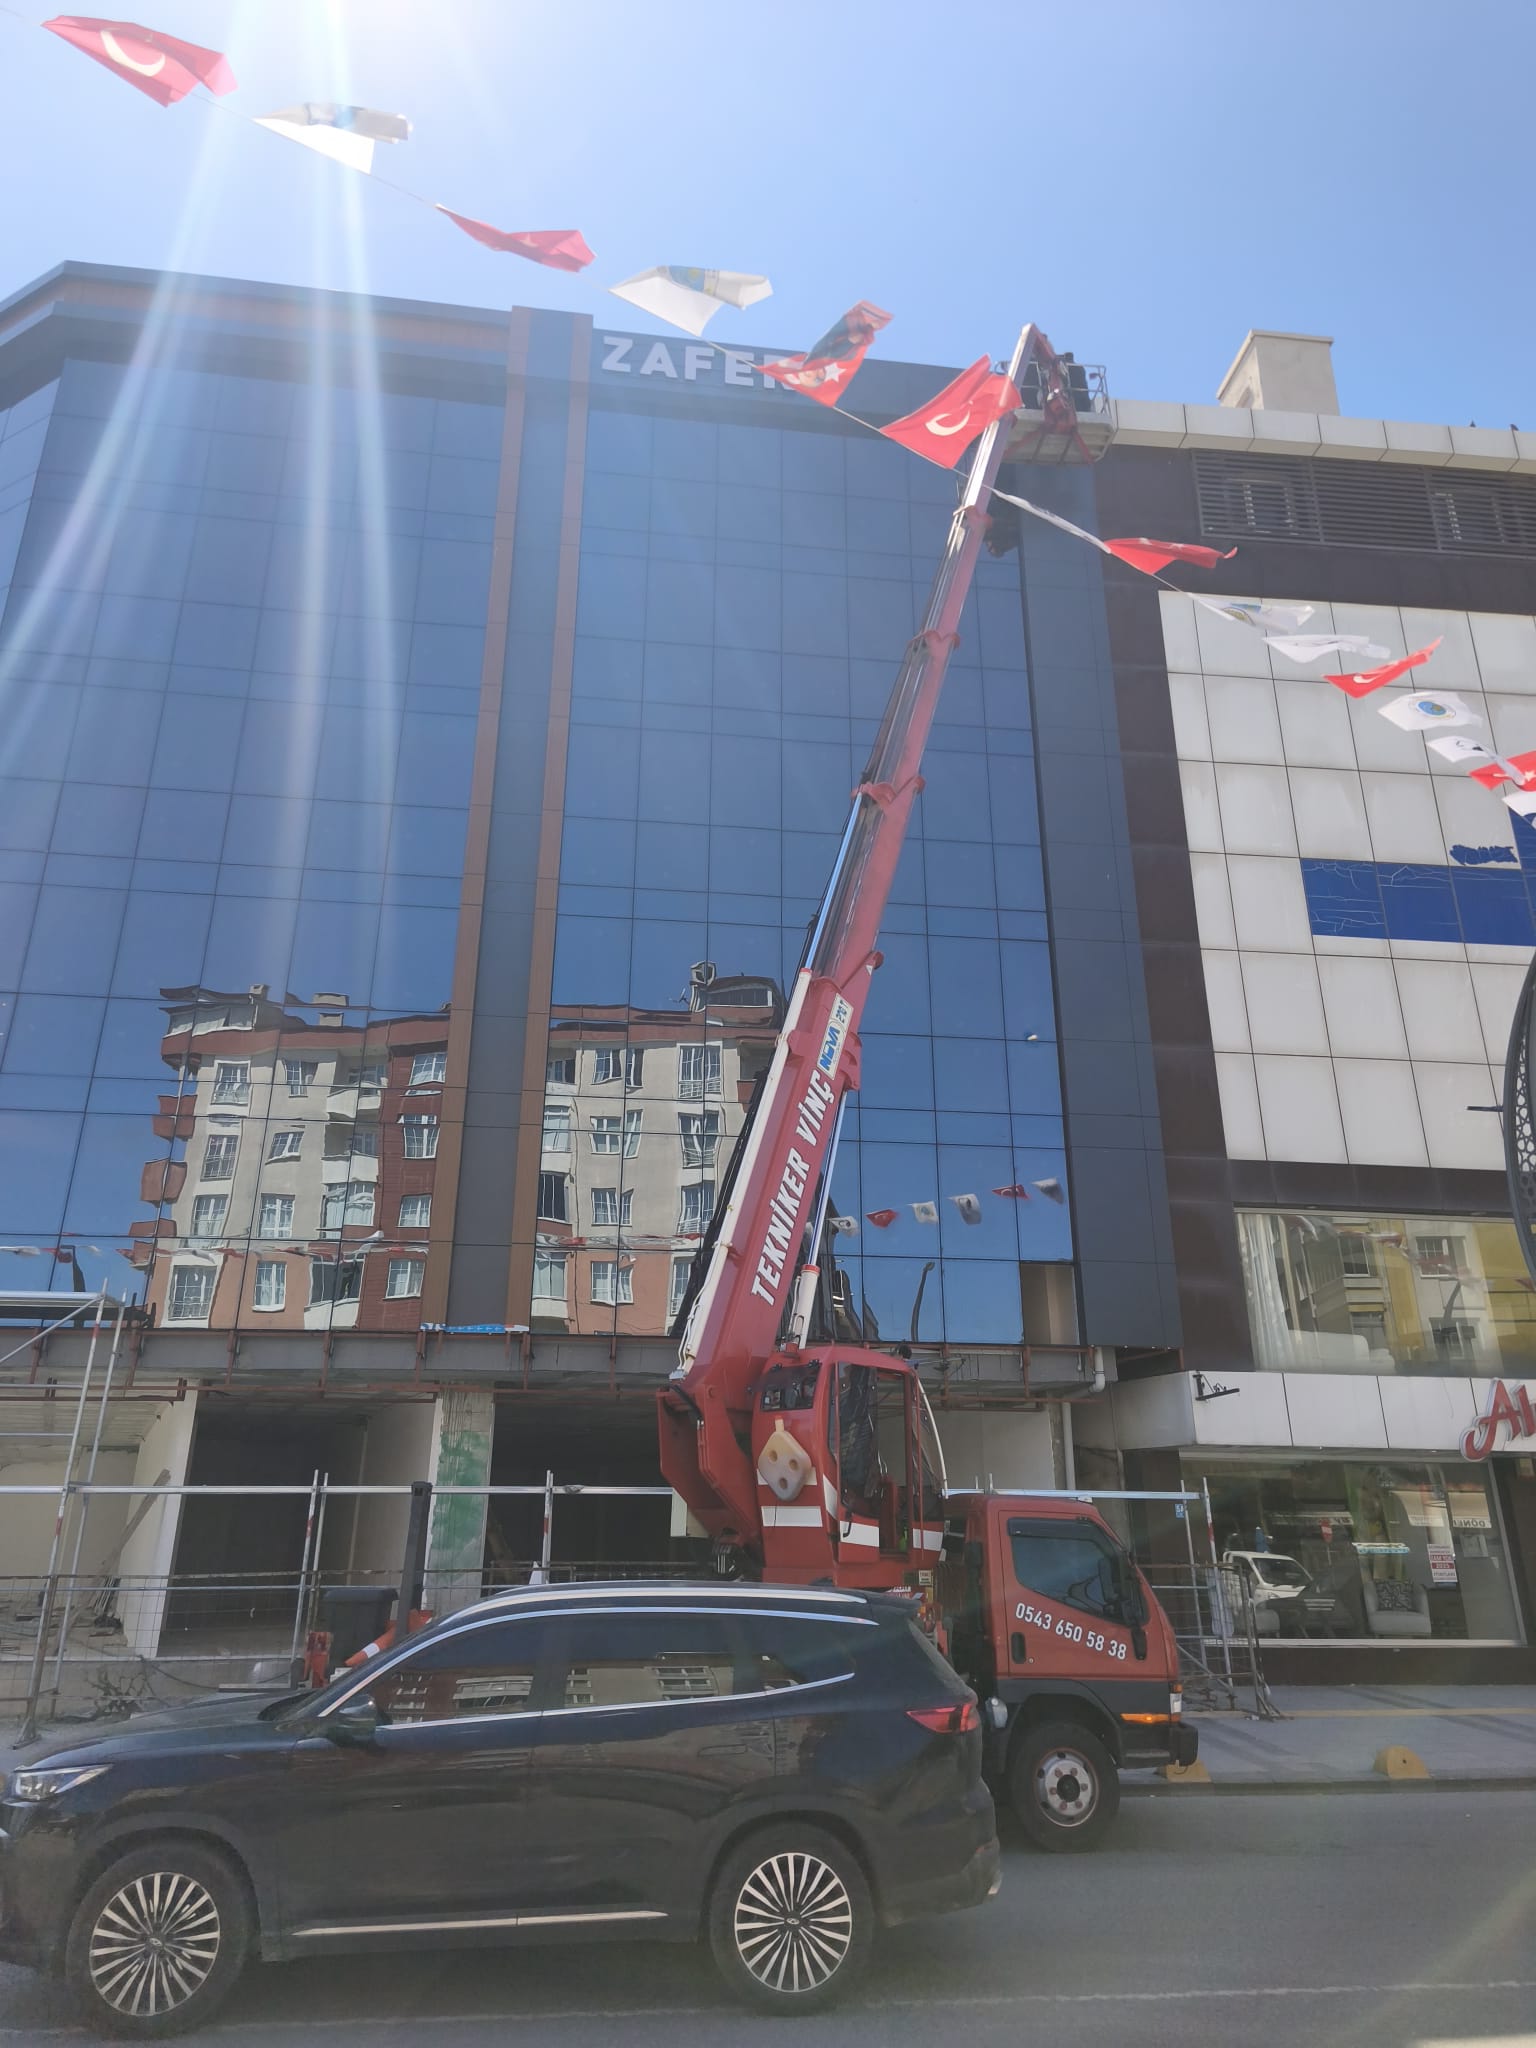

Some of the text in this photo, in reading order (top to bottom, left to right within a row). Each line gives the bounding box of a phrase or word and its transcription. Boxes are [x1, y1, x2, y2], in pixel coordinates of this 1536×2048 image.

[751, 1070, 834, 1306] TEKNİKER VİNÇ
[1015, 1603, 1127, 1660] 0543 650 58 38
